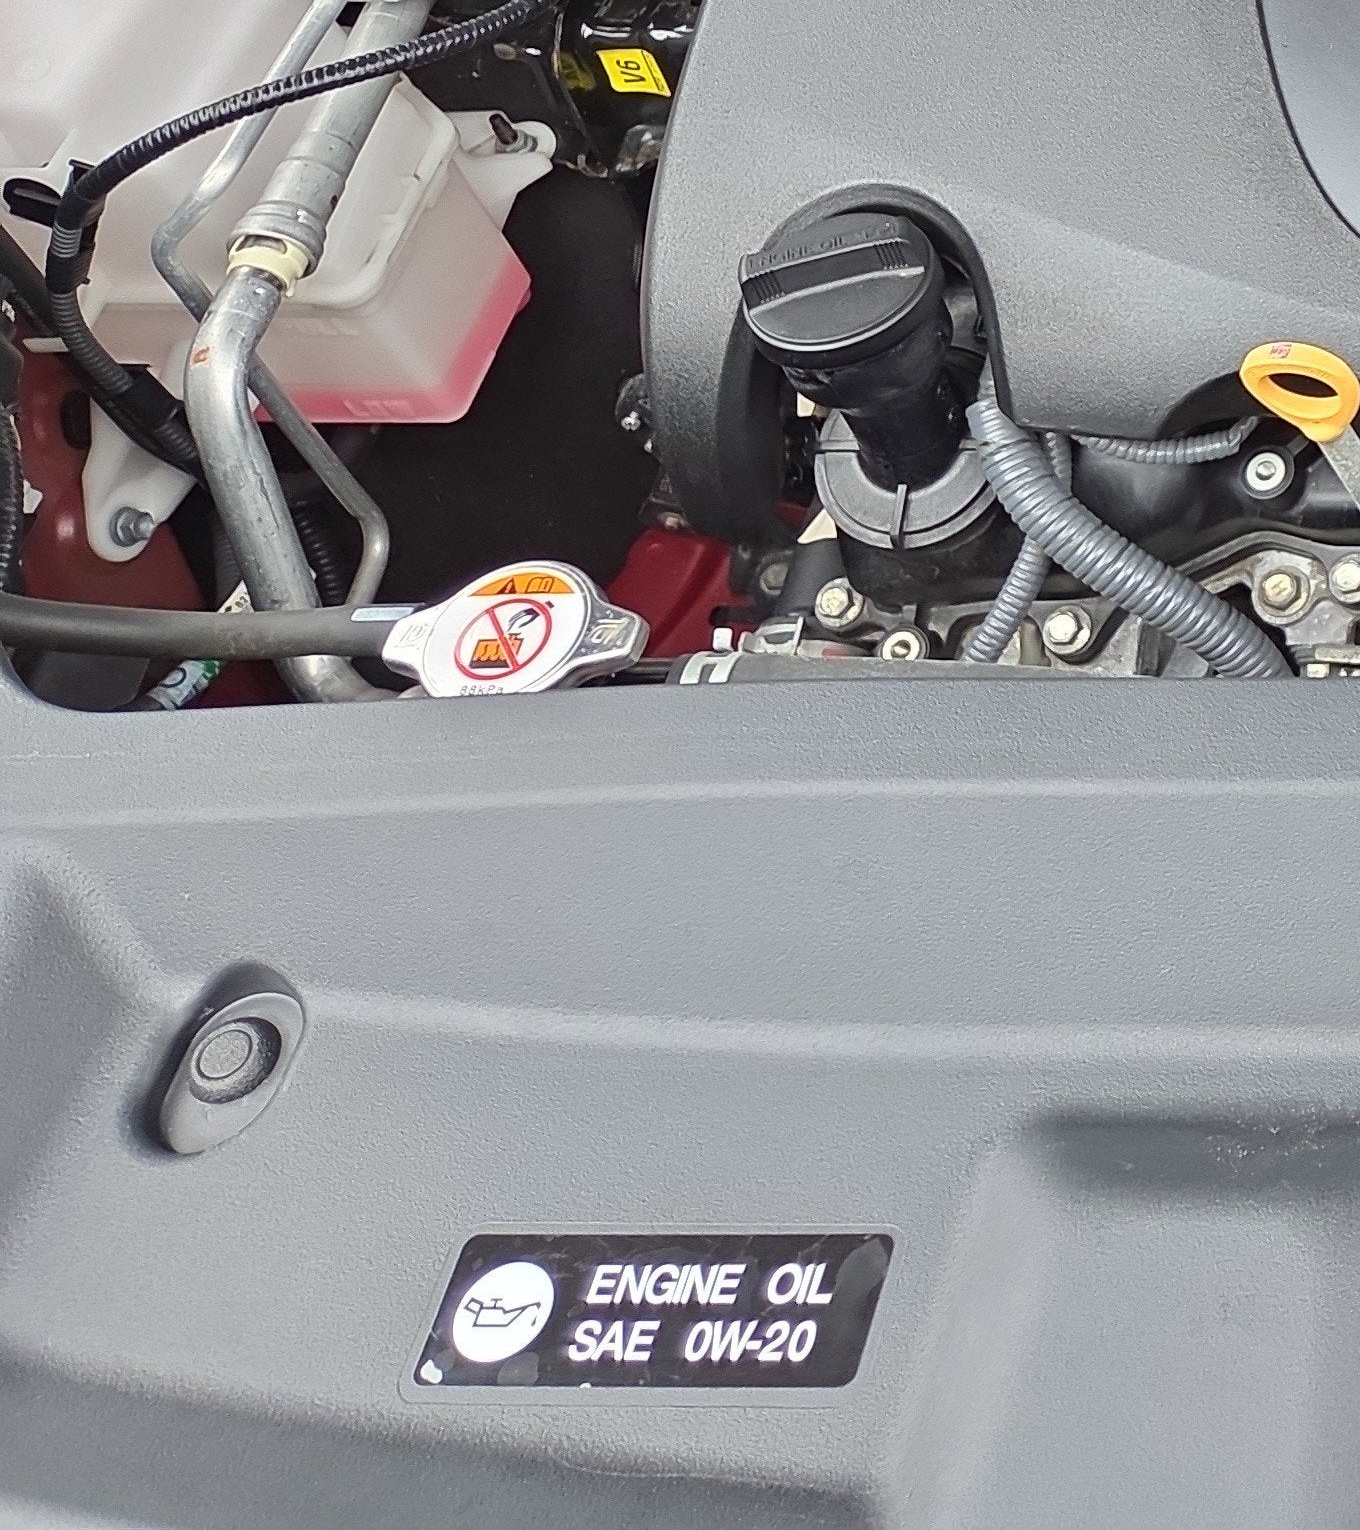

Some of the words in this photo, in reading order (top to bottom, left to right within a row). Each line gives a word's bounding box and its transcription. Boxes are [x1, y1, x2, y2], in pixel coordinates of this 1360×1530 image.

[615, 58, 647, 84] V6
[585, 1263, 747, 1305] ENGINE
[765, 1262, 834, 1305] OIL
[567, 1319, 660, 1363] SAE
[683, 1319, 818, 1363] 0W-20
